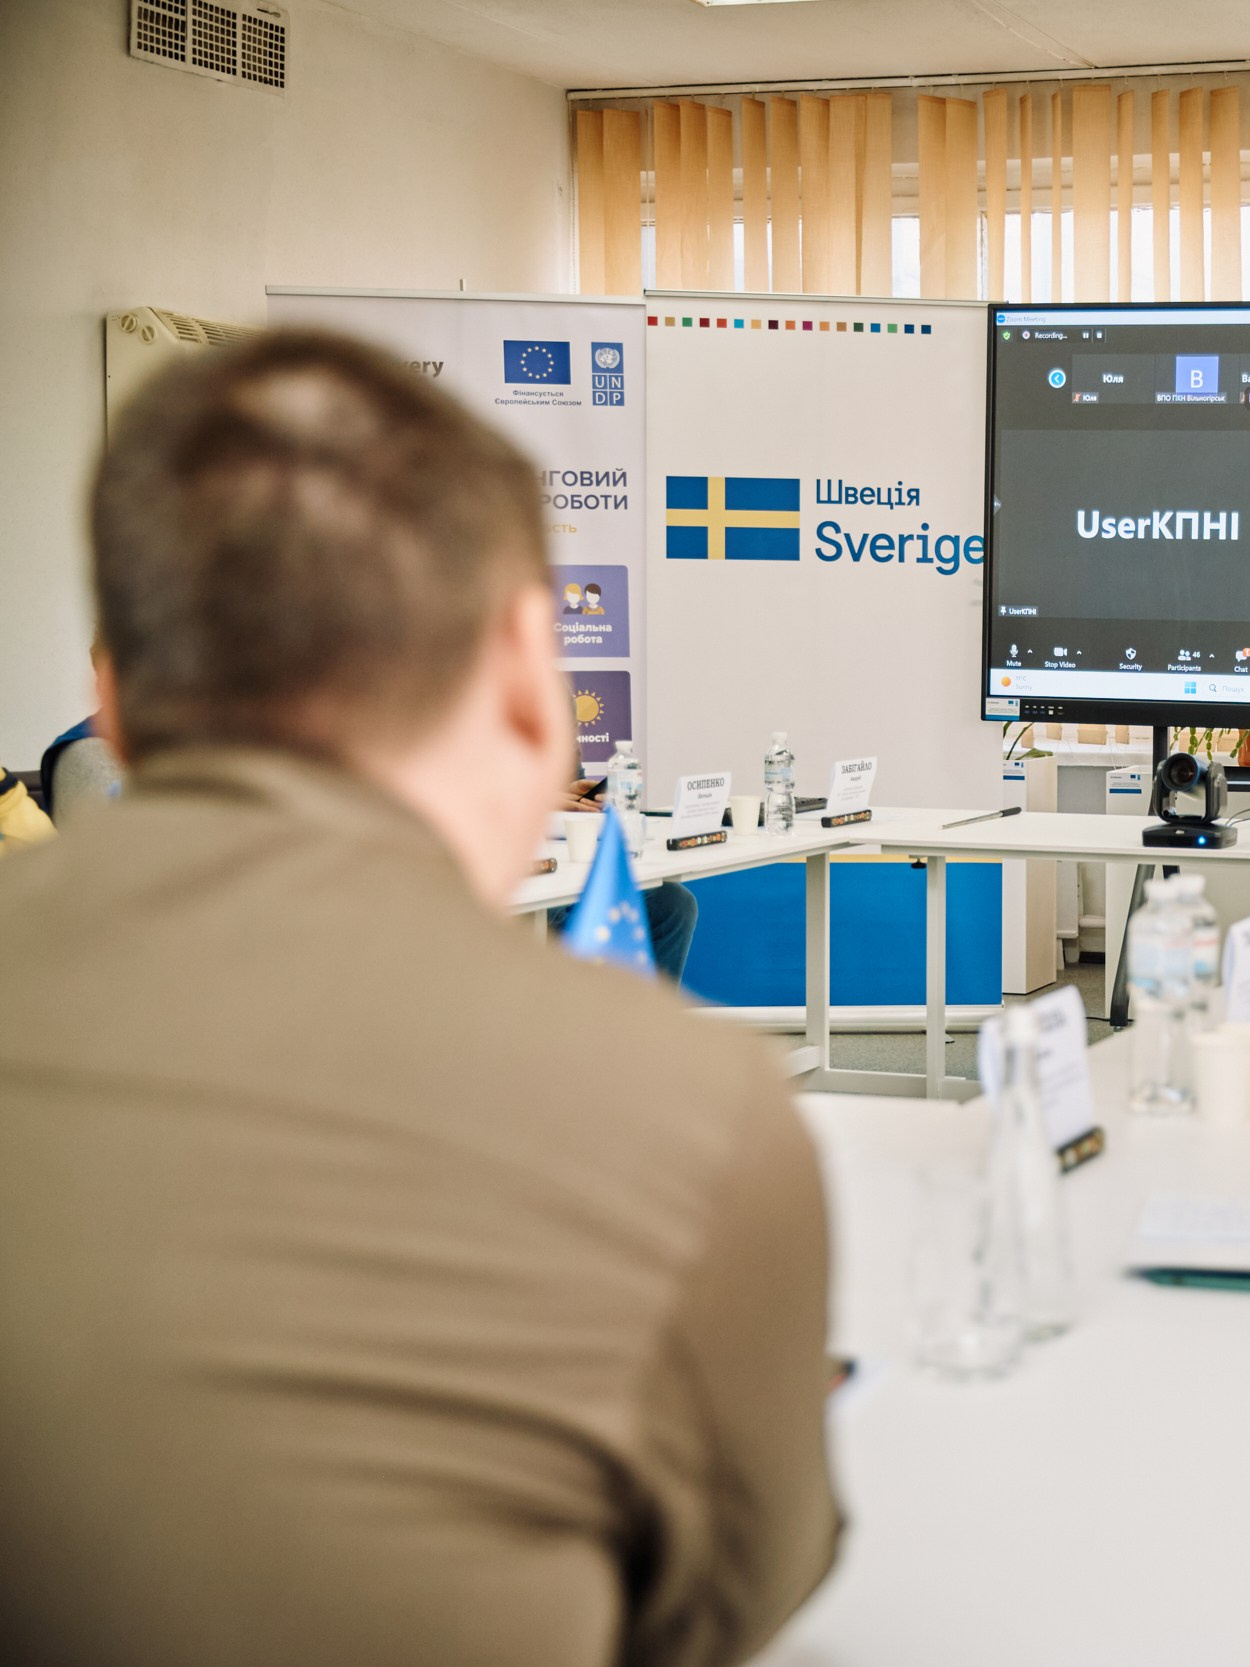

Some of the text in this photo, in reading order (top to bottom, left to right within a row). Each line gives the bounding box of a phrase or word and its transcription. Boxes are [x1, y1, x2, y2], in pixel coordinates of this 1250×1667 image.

[1102, 373, 1124, 384] Юля
[512, 389, 564, 398] Фінансується
[1082, 394, 1098, 402] Юля
[494, 397, 582, 407] Європейським Союзом
[815, 478, 921, 510] Швеція
[815, 520, 985, 576] Sverige
[554, 622, 613, 633] Соціальна
[563, 634, 603, 646] робота
[1192, 651, 1201, 659] 46
[1044, 661, 1058, 669] Stop
[1119, 663, 1142, 671] Security
[1167, 663, 1202, 672] Participants
[1234, 665, 1249, 673] Chat
[687, 777, 726, 791] ОСИПЕНКО
